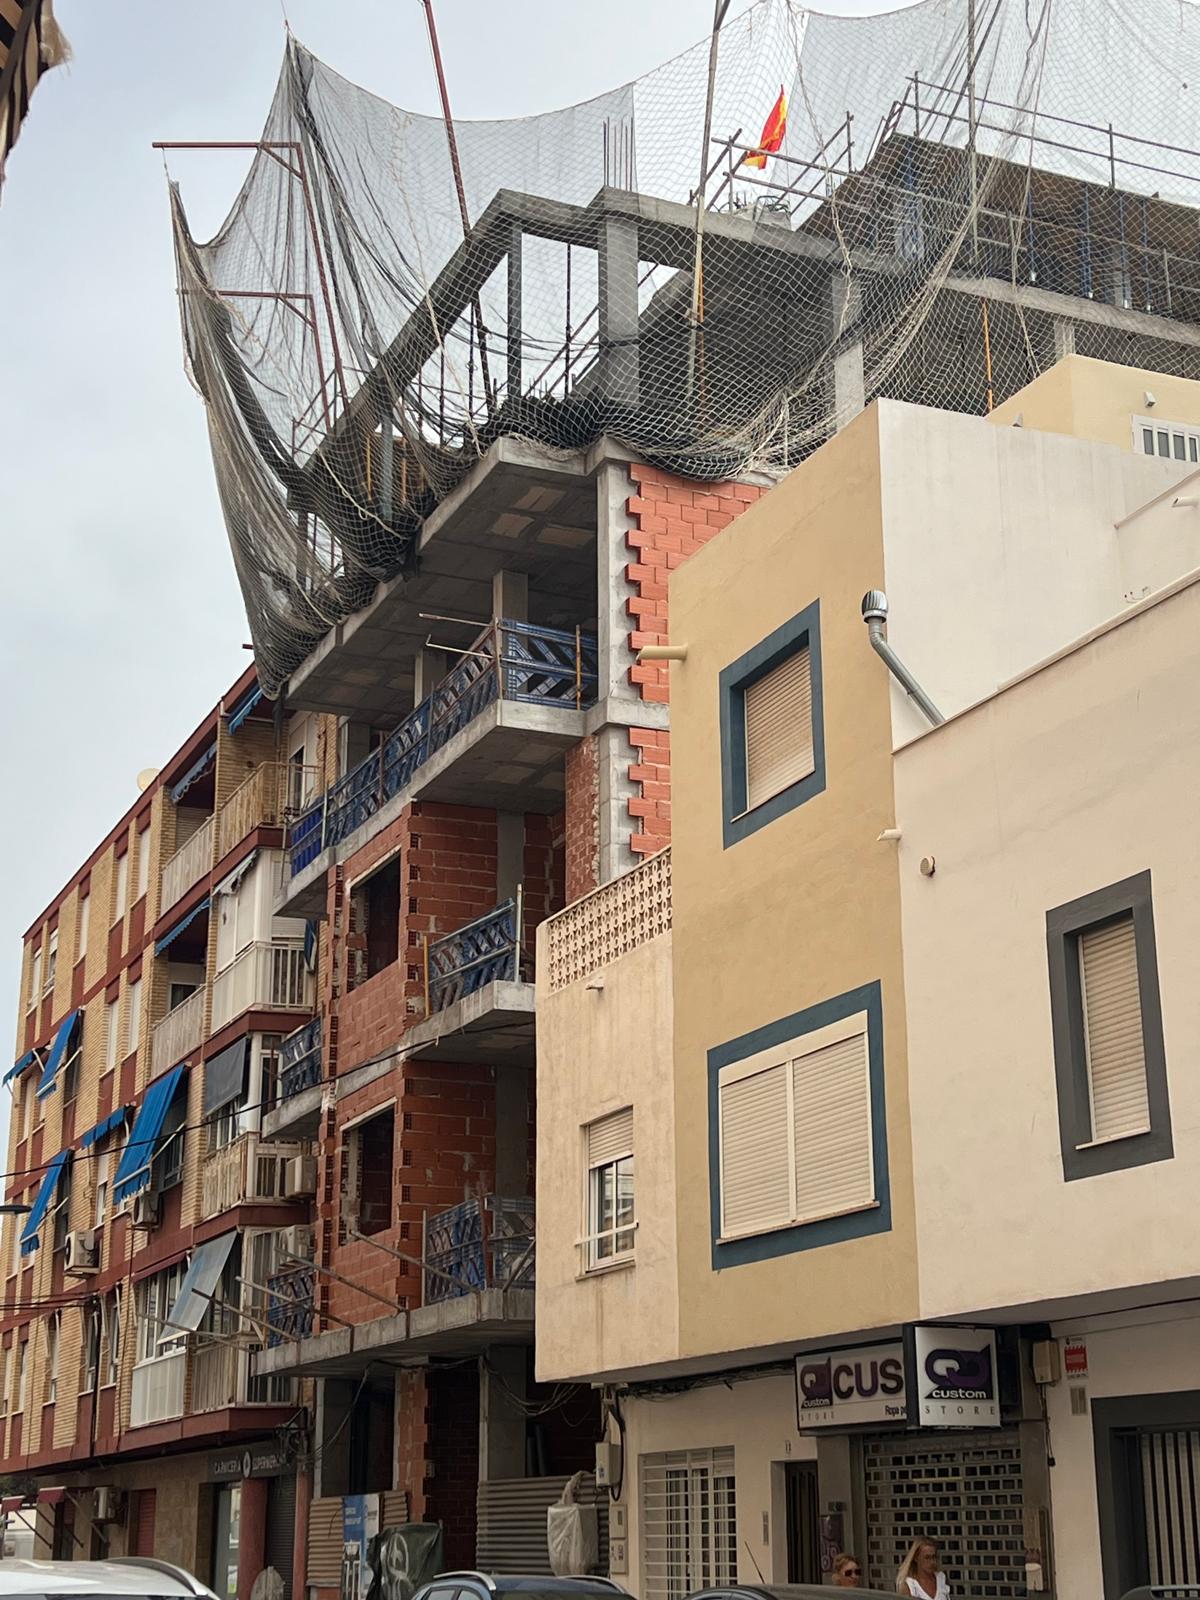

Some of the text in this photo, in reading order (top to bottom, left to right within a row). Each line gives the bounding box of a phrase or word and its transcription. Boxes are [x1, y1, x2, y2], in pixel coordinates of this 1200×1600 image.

[932, 1388, 987, 1399] custom
[803, 1398, 831, 1409] custom
[924, 1405, 996, 1415] STORE
